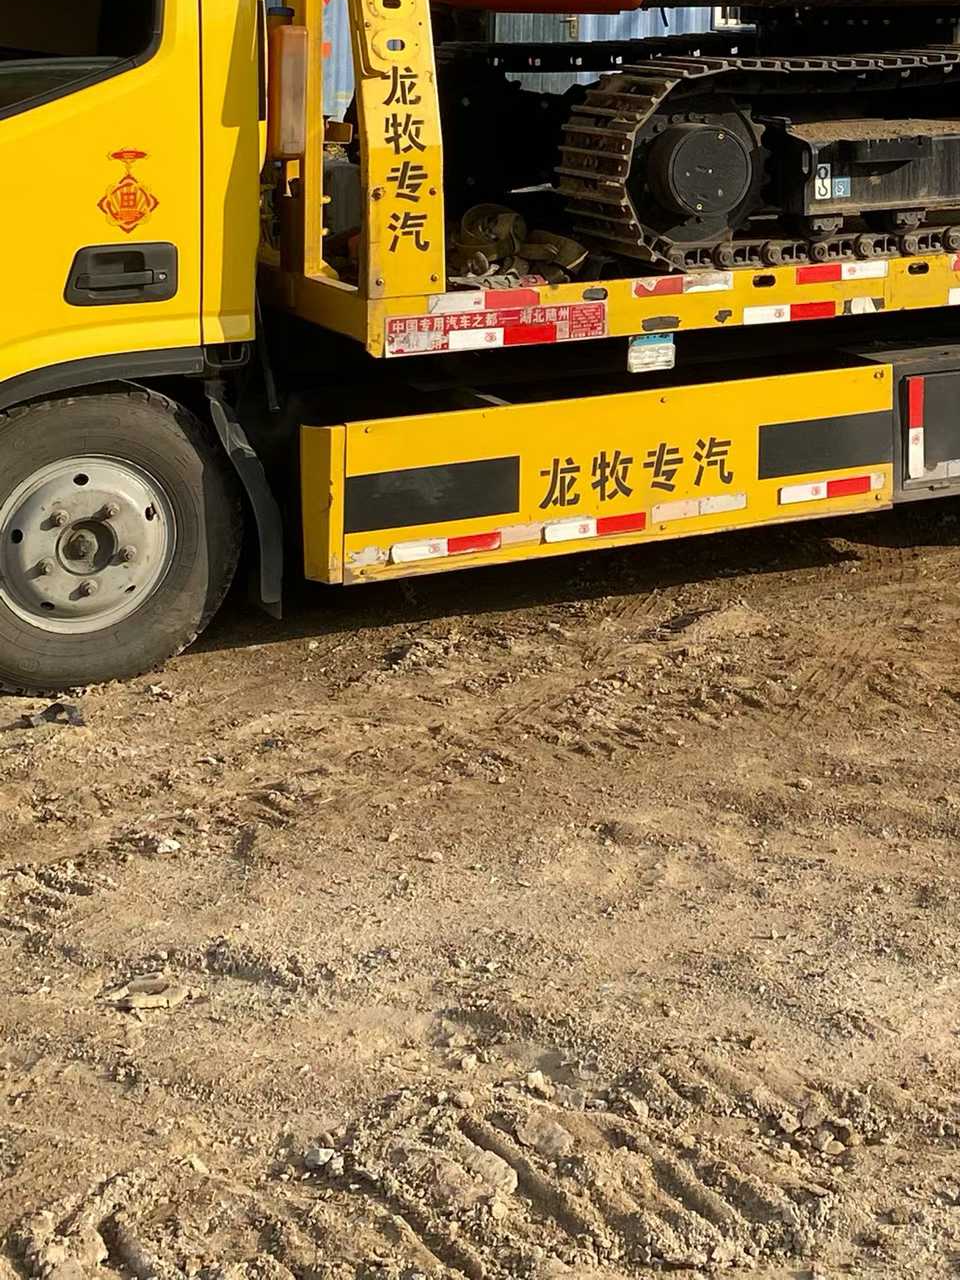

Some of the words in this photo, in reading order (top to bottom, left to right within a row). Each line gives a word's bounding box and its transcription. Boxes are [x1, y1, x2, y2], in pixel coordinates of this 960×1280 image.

[379, 65, 431, 253] 龙牧专汽
[538, 436, 734, 510] 龙牧专汽
